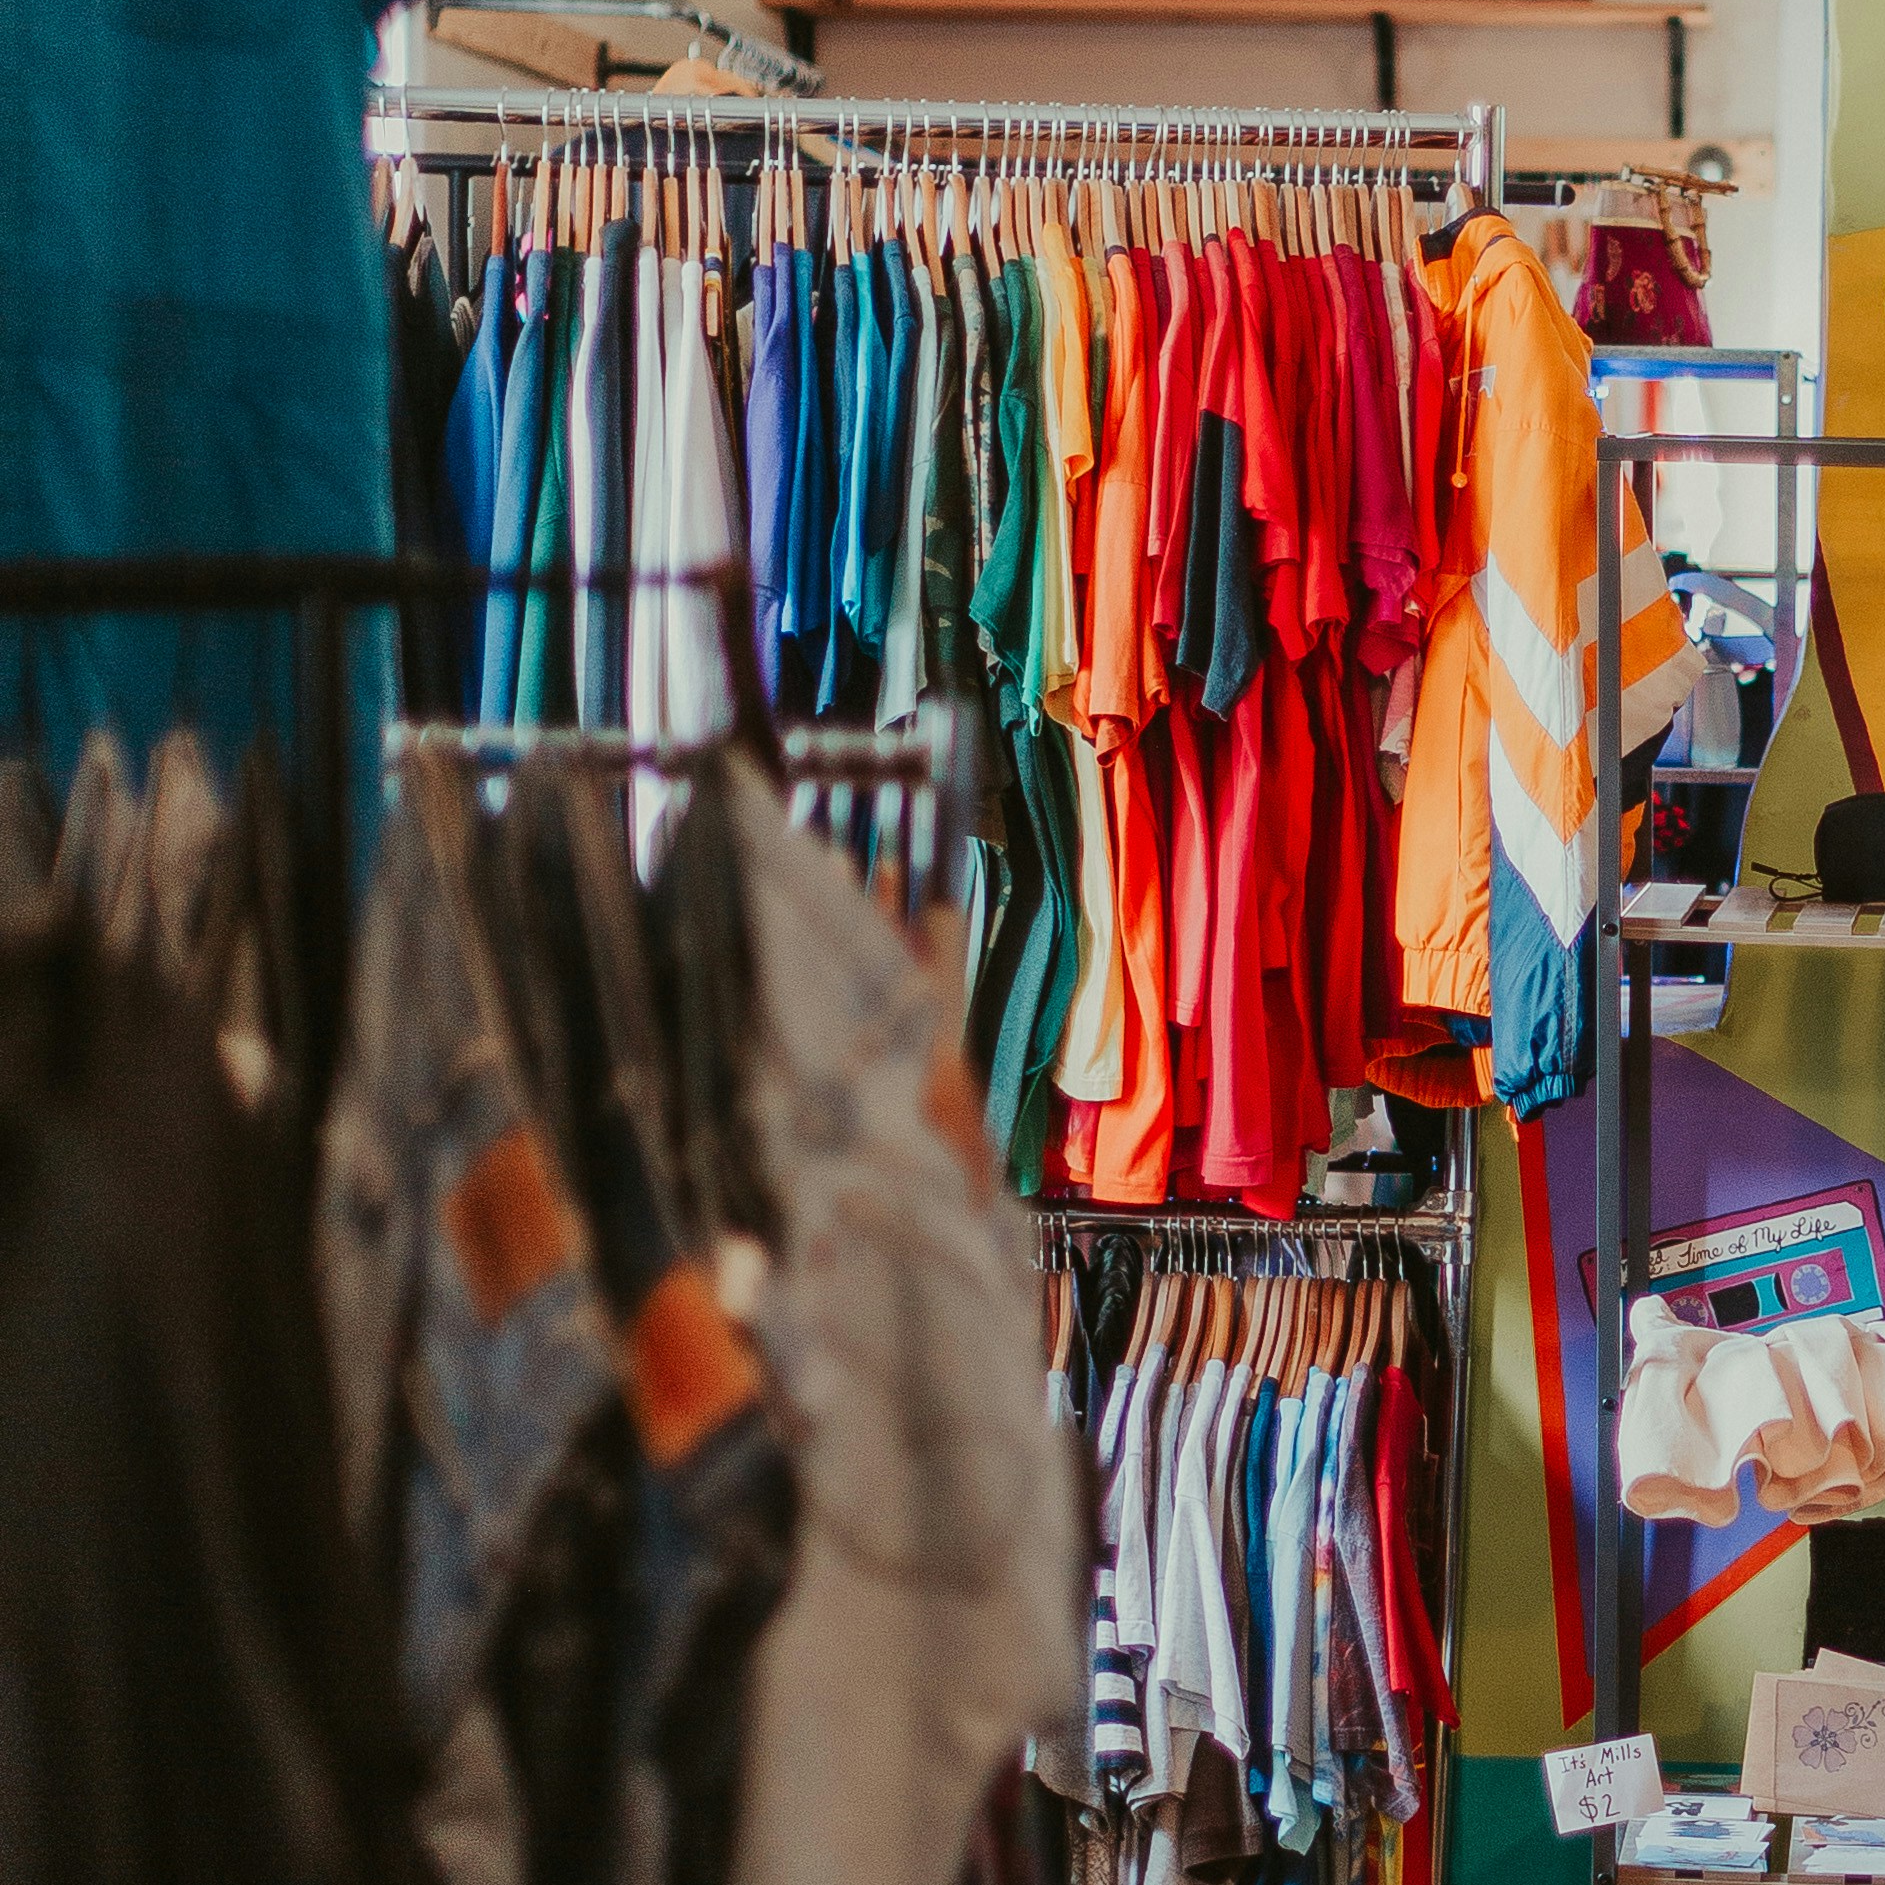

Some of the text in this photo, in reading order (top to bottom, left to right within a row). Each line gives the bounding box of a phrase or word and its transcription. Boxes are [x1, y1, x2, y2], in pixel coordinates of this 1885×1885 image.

[1676, 1242, 1724, 1269] Time
[1728, 1234, 1748, 1254] of
[1752, 1226, 1787, 1253] My
[1790, 1216, 1838, 1240] Life
[1557, 1743, 1642, 1774] It's Mills
[1585, 1766, 1614, 1789] Art
[1578, 1793, 1621, 1823] $2
